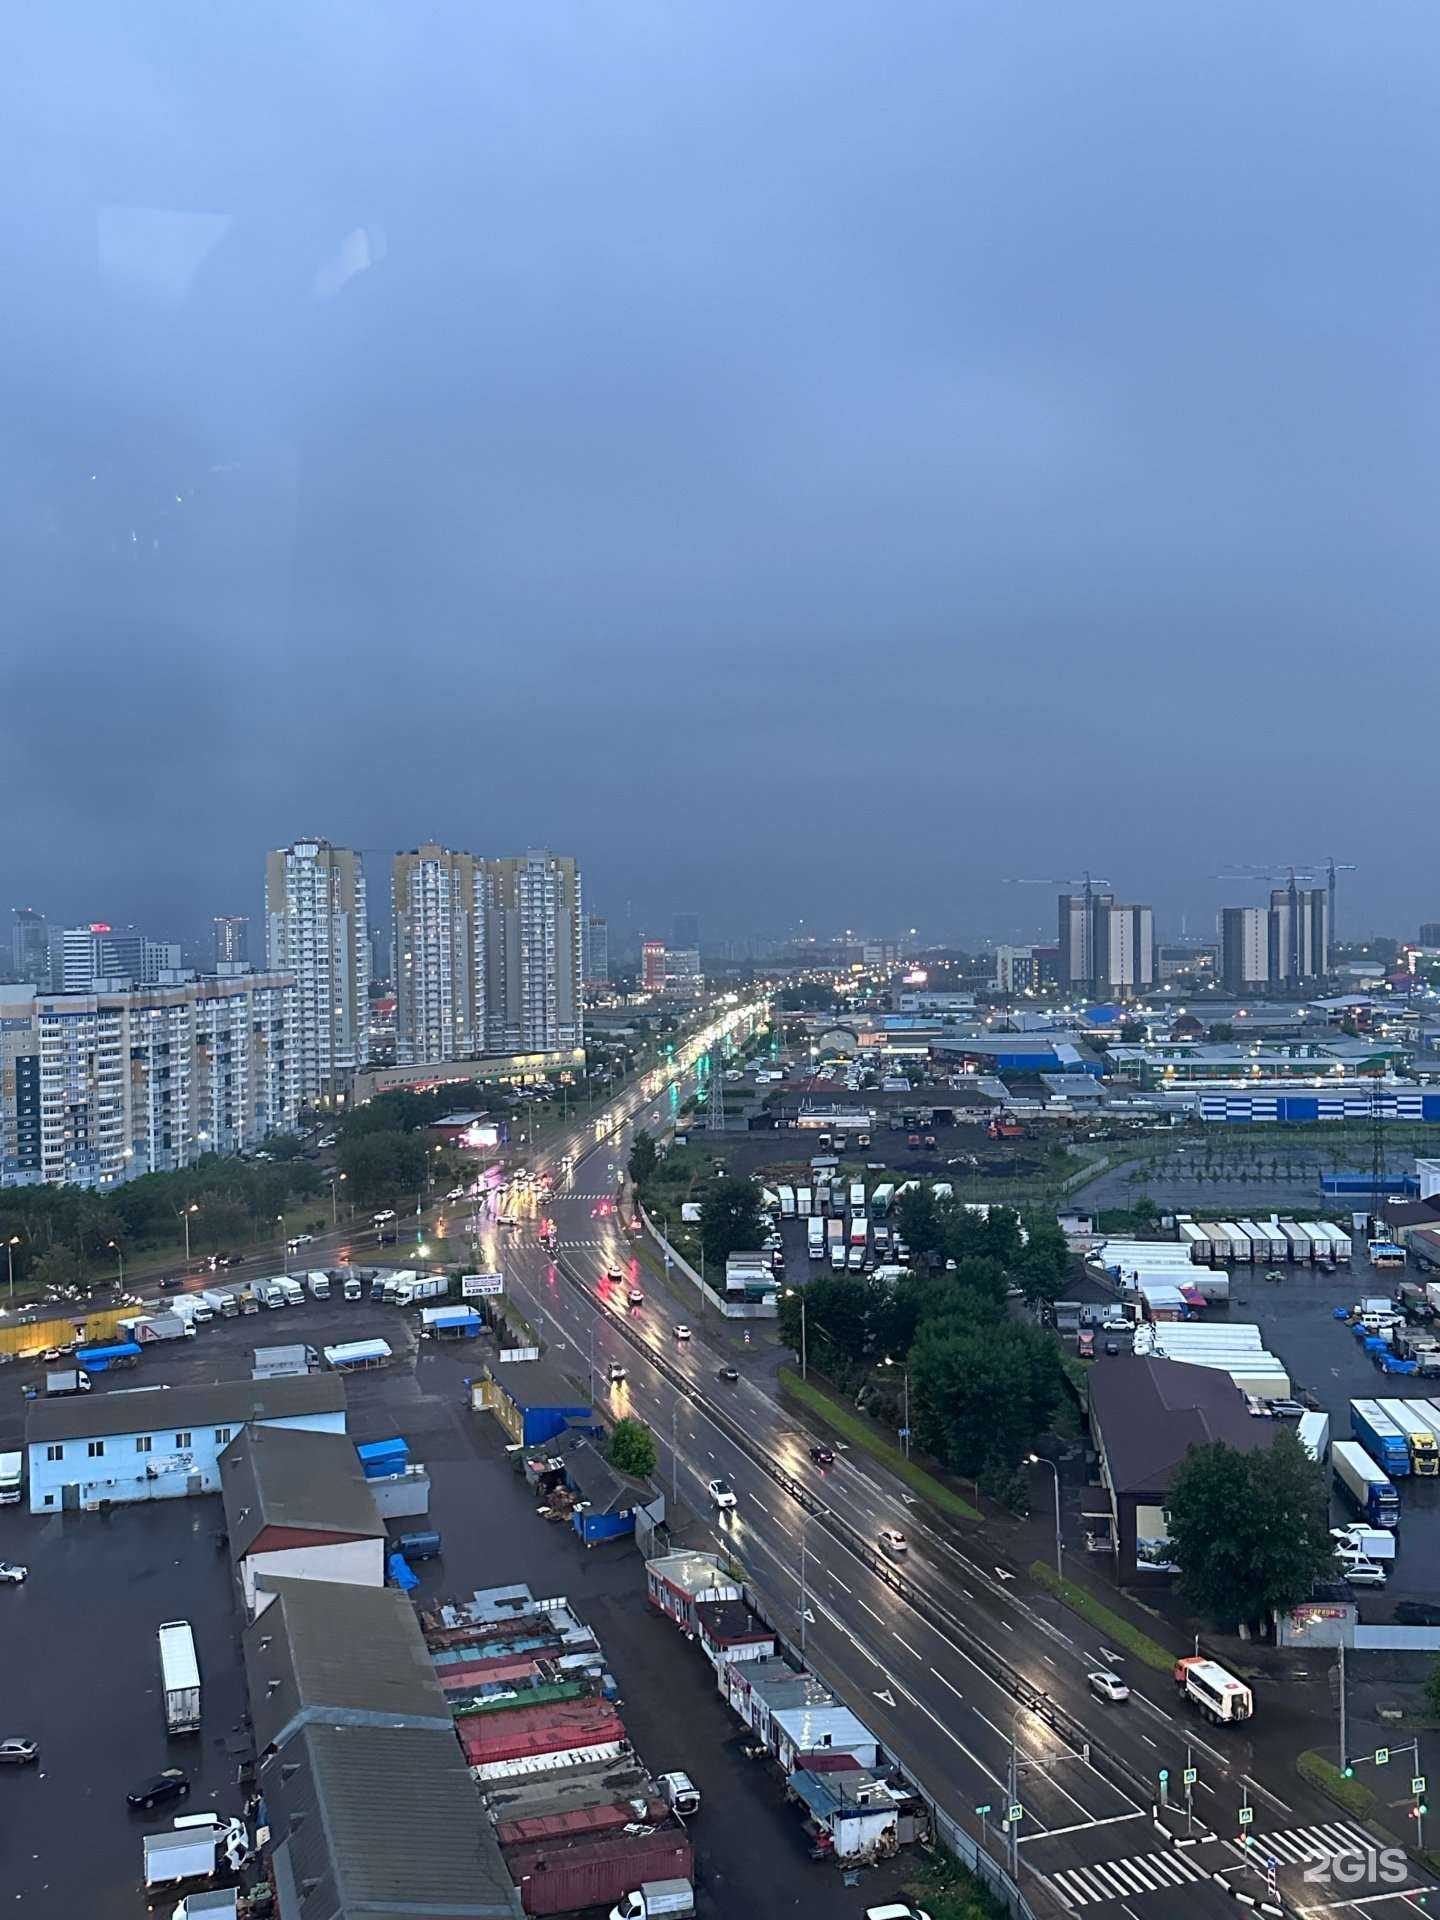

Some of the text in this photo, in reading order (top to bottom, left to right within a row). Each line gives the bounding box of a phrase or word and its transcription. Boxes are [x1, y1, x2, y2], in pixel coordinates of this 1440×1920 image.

[994, 1566, 1016, 1580] А
[1099, 1646, 1125, 1663] А
[872, 1689, 896, 1707] А
